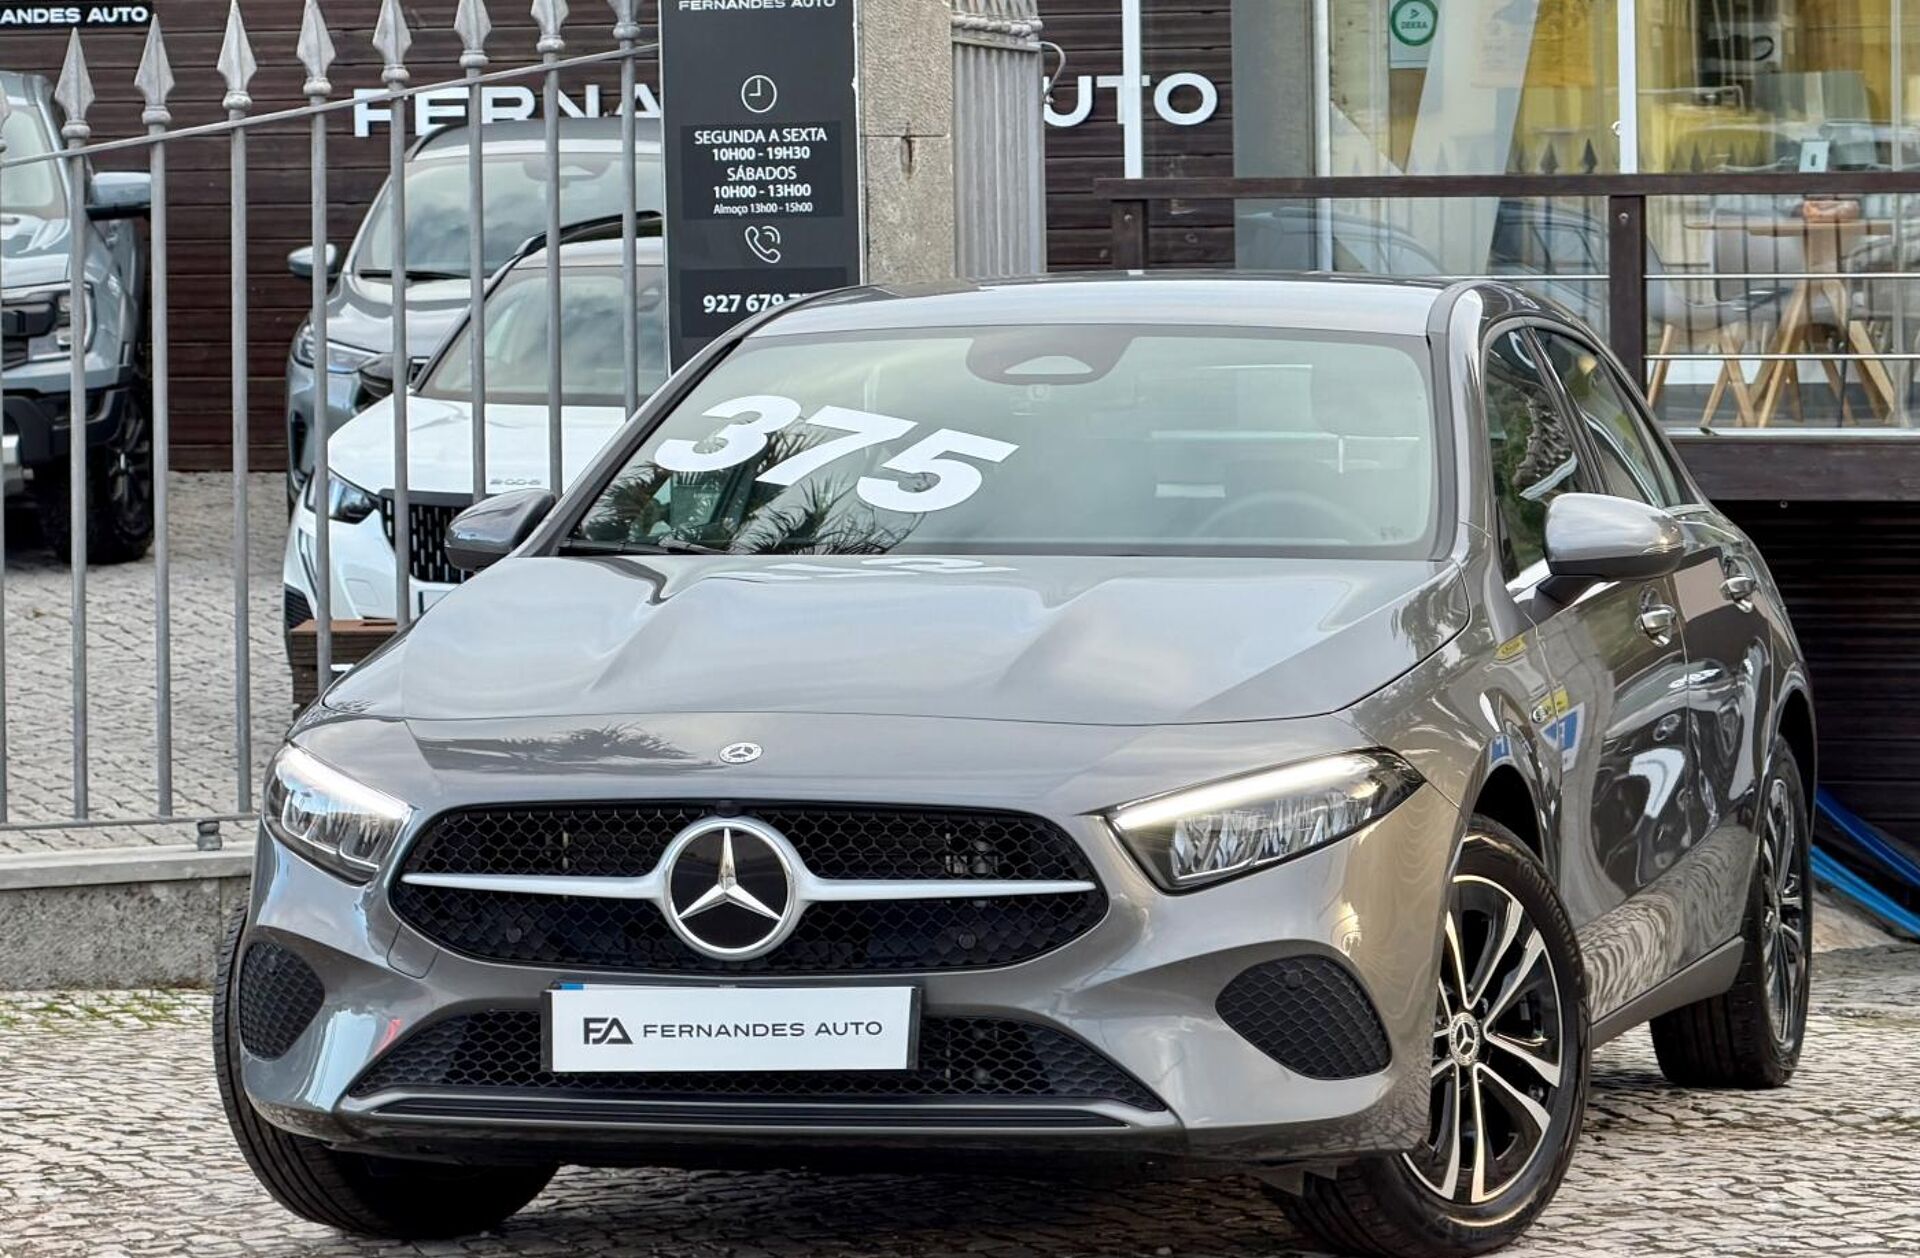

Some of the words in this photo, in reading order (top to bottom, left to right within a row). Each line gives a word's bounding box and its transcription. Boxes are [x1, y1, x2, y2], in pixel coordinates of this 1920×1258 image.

[678, 0, 786, 11] FERNANDES
[791, 0, 836, 8] AUTO
[86, 6, 149, 23] AUTO
[694, 129, 766, 144] SEGUNDA
[768, 128, 780, 143] A
[782, 127, 828, 142] SEXTA
[712, 147, 756, 161] 10H00
[766, 146, 811, 160] 19H30
[727, 164, 797, 181] SÁBADOS
[713, 185, 757, 199] 10H00
[767, 184, 812, 197] 13H00
[713, 203, 748, 216] Almoço
[750, 203, 777, 213] 13h00
[785, 202, 813, 213] 15h00
[703, 294, 742, 314] 927
[745, 294, 784, 312] 679
[655, 395, 1020, 512] 375
[643, 1023, 805, 1038] FERNANDES
[815, 1020, 883, 1036] AUTO
